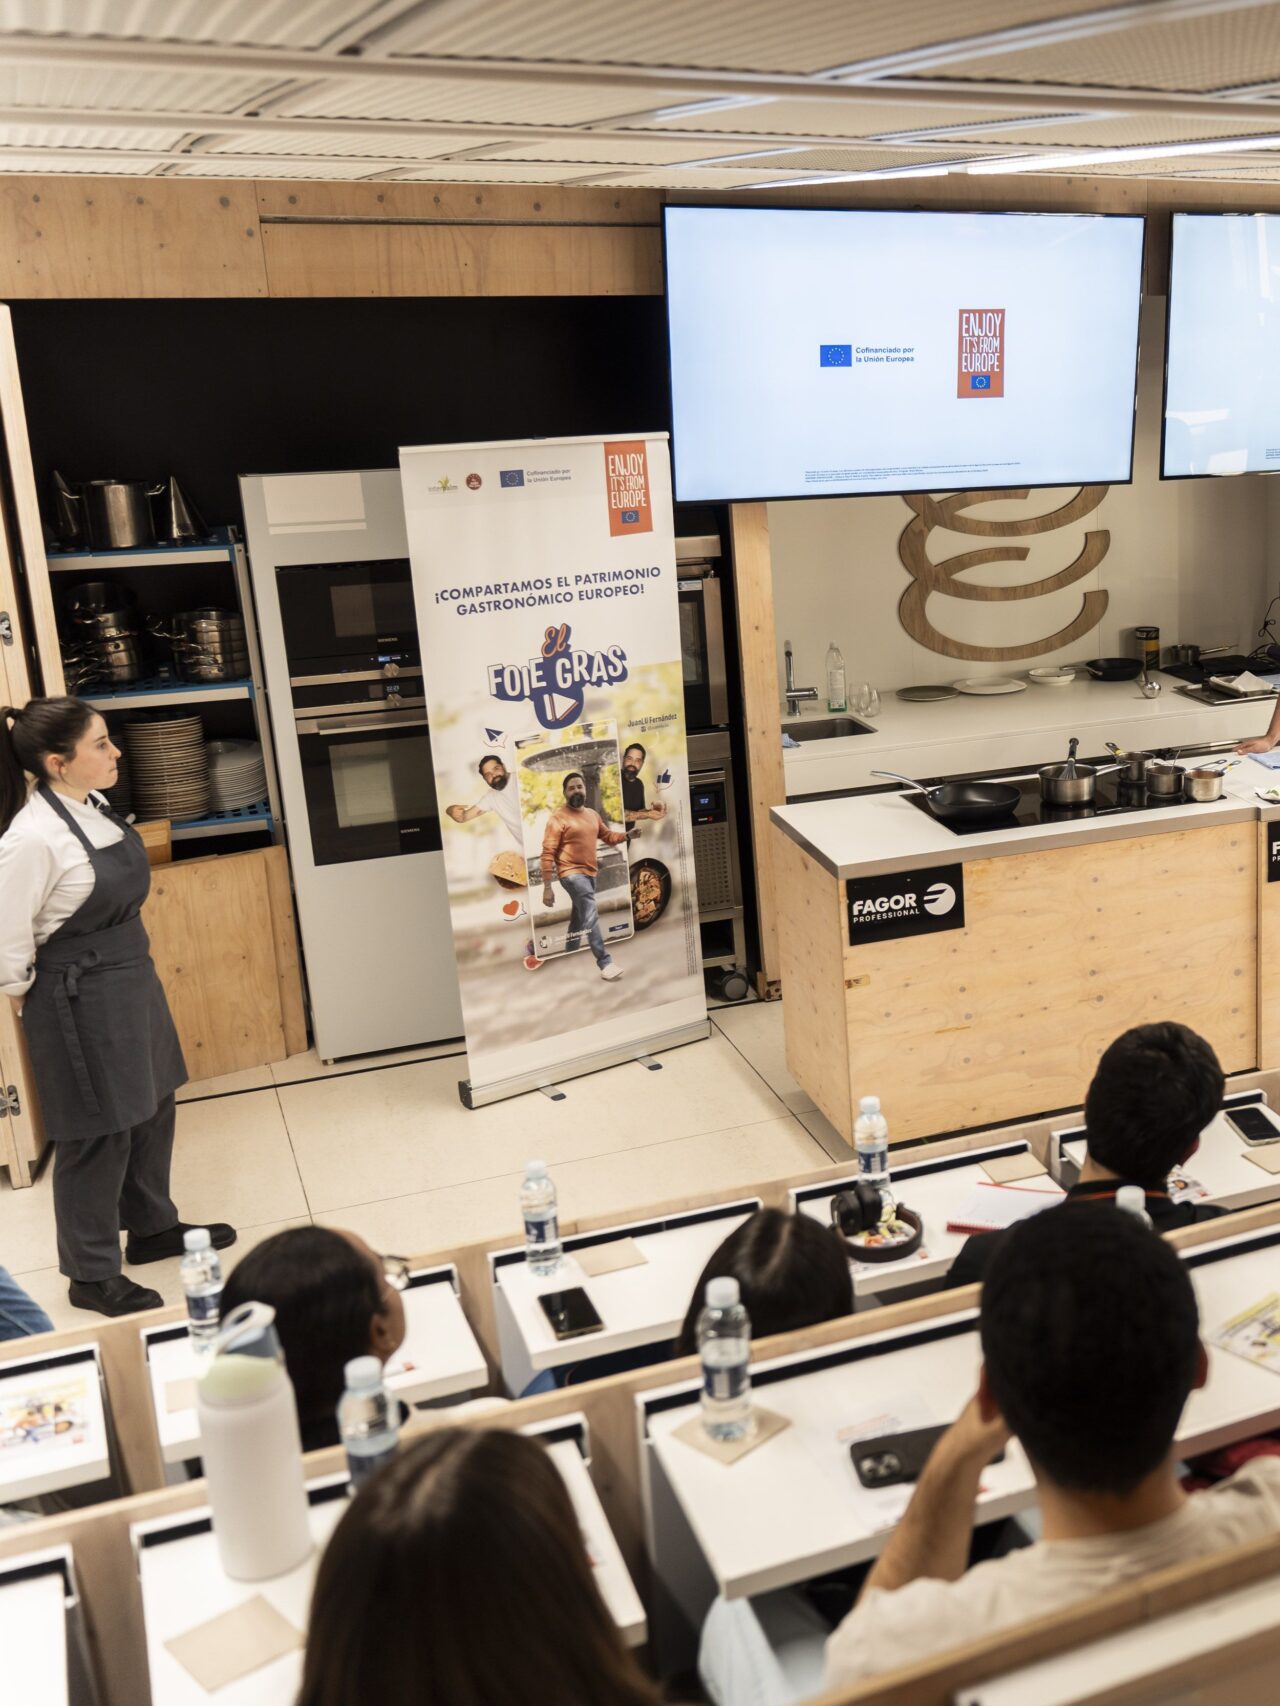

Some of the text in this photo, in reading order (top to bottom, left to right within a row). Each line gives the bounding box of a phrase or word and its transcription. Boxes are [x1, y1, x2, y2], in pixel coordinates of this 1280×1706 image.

[962, 313, 1002, 337] ENJOY
[902, 347, 914, 355] por
[962, 336, 1000, 353] IT'S FROM
[961, 353, 1000, 372] EUROPE
[607, 453, 645, 477] ENJOY
[611, 474, 645, 491] IT'S FROM
[611, 489, 647, 509] EUROPE
[434, 567, 661, 604] ¡COMPARTAMOS EL PATRIMONIO
[456, 583, 645, 616] GASTRONÓMICO EUROPEO!
[541, 623, 570, 658] El
[487, 645, 625, 697] FOIE GRAS
[853, 893, 917, 915] FAGOR
[853, 909, 920, 923] PROFESSIONAL
